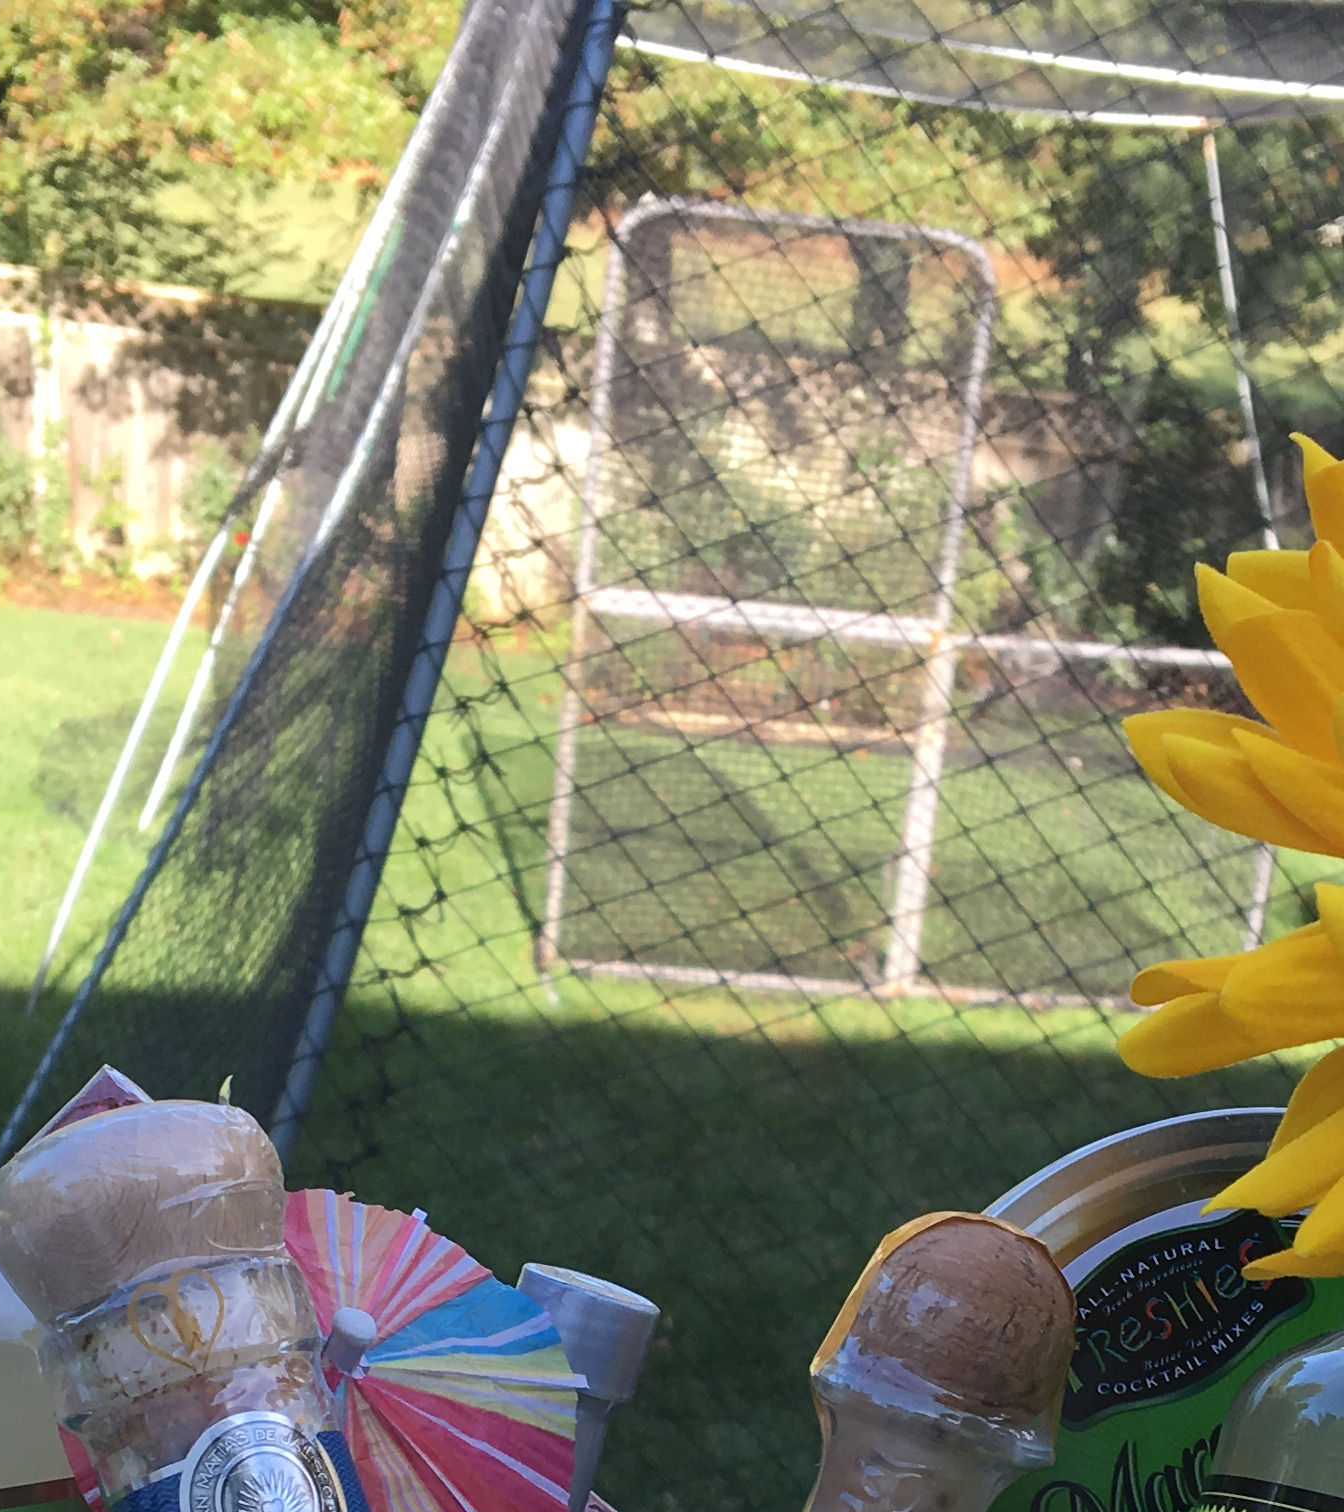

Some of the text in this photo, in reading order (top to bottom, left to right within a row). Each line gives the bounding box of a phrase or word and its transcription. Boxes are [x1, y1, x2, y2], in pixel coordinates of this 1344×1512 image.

[1077, 1237, 1227, 1321] ALL-NATURAL
[1096, 1300, 1265, 1396] COCKTAIL MIXES
[196, 1429, 251, 1490] MATIAS
[255, 1429, 276, 1441] DE
